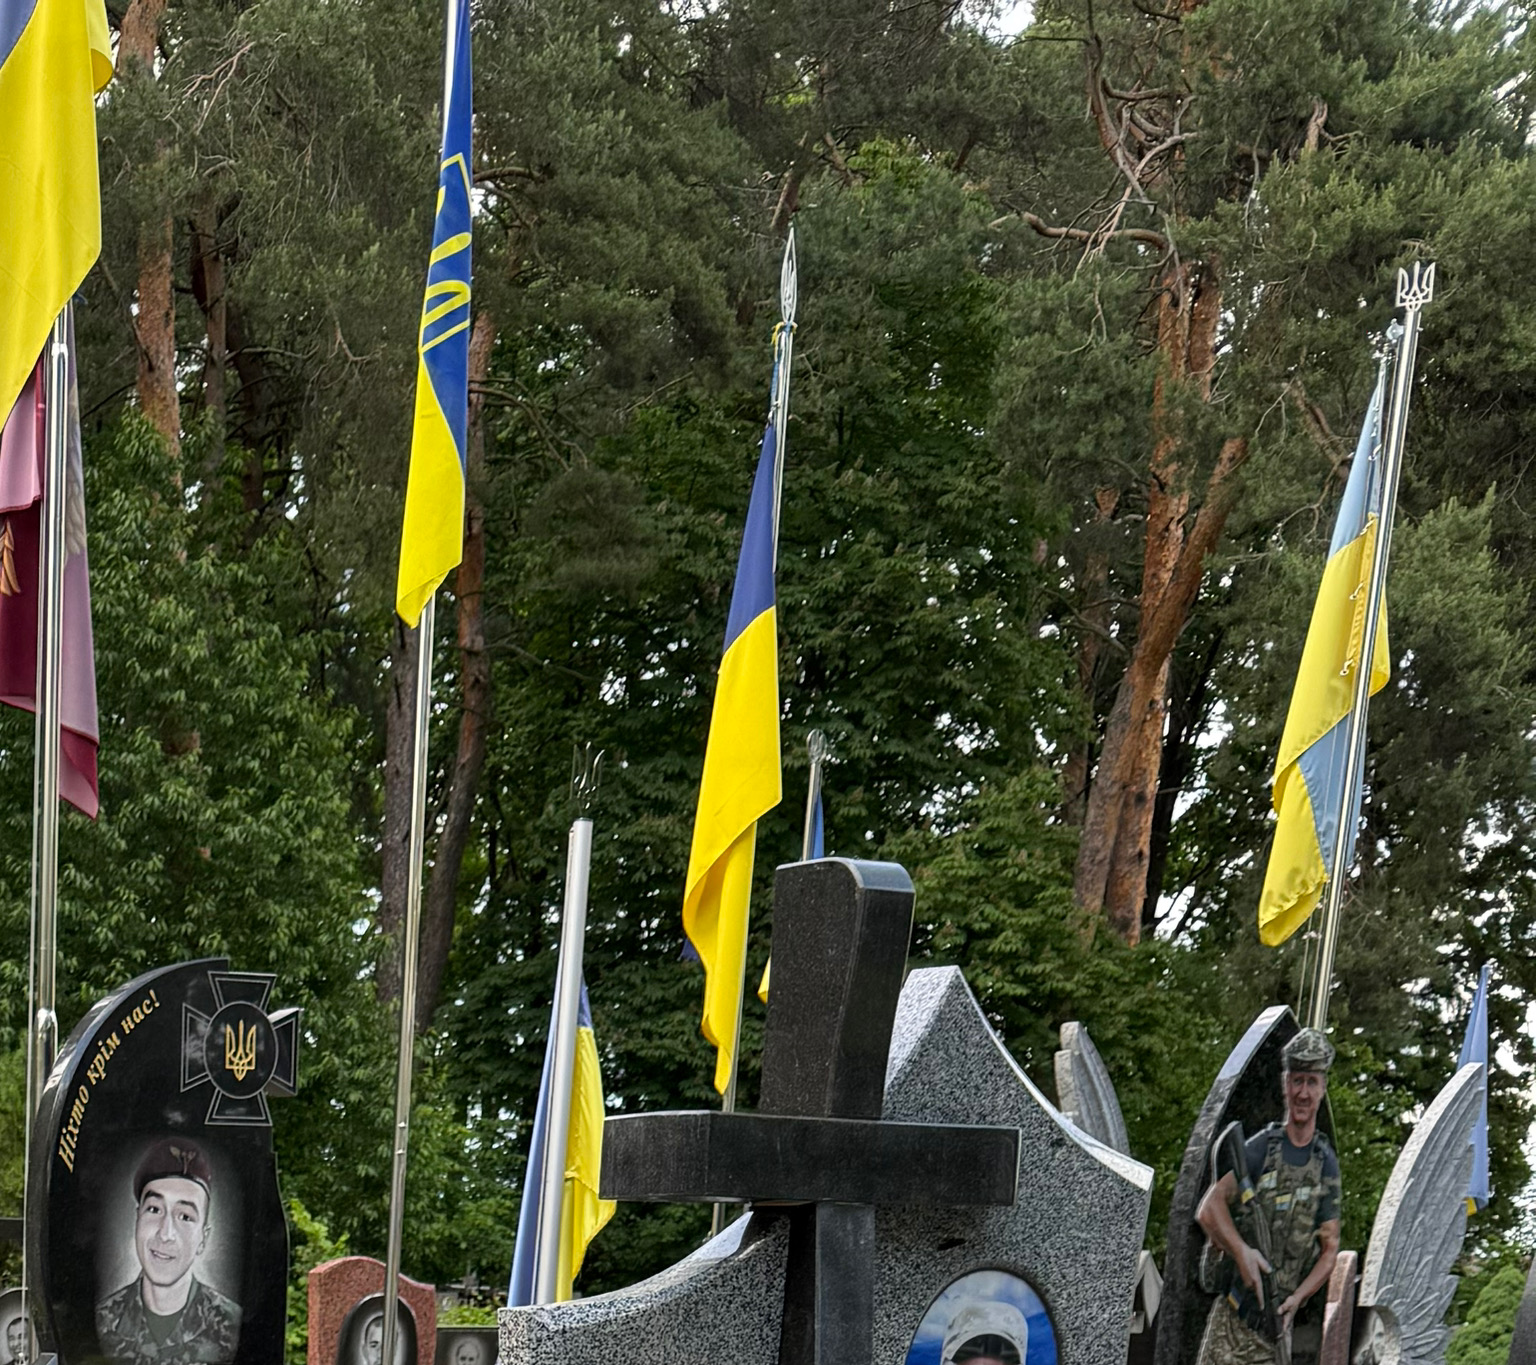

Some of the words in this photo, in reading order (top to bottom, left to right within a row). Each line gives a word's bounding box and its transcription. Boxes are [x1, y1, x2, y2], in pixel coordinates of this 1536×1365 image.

[58, 1085, 90, 1174] Ніхто
[87, 1031, 121, 1086] крім
[120, 989, 160, 1035] нас!
